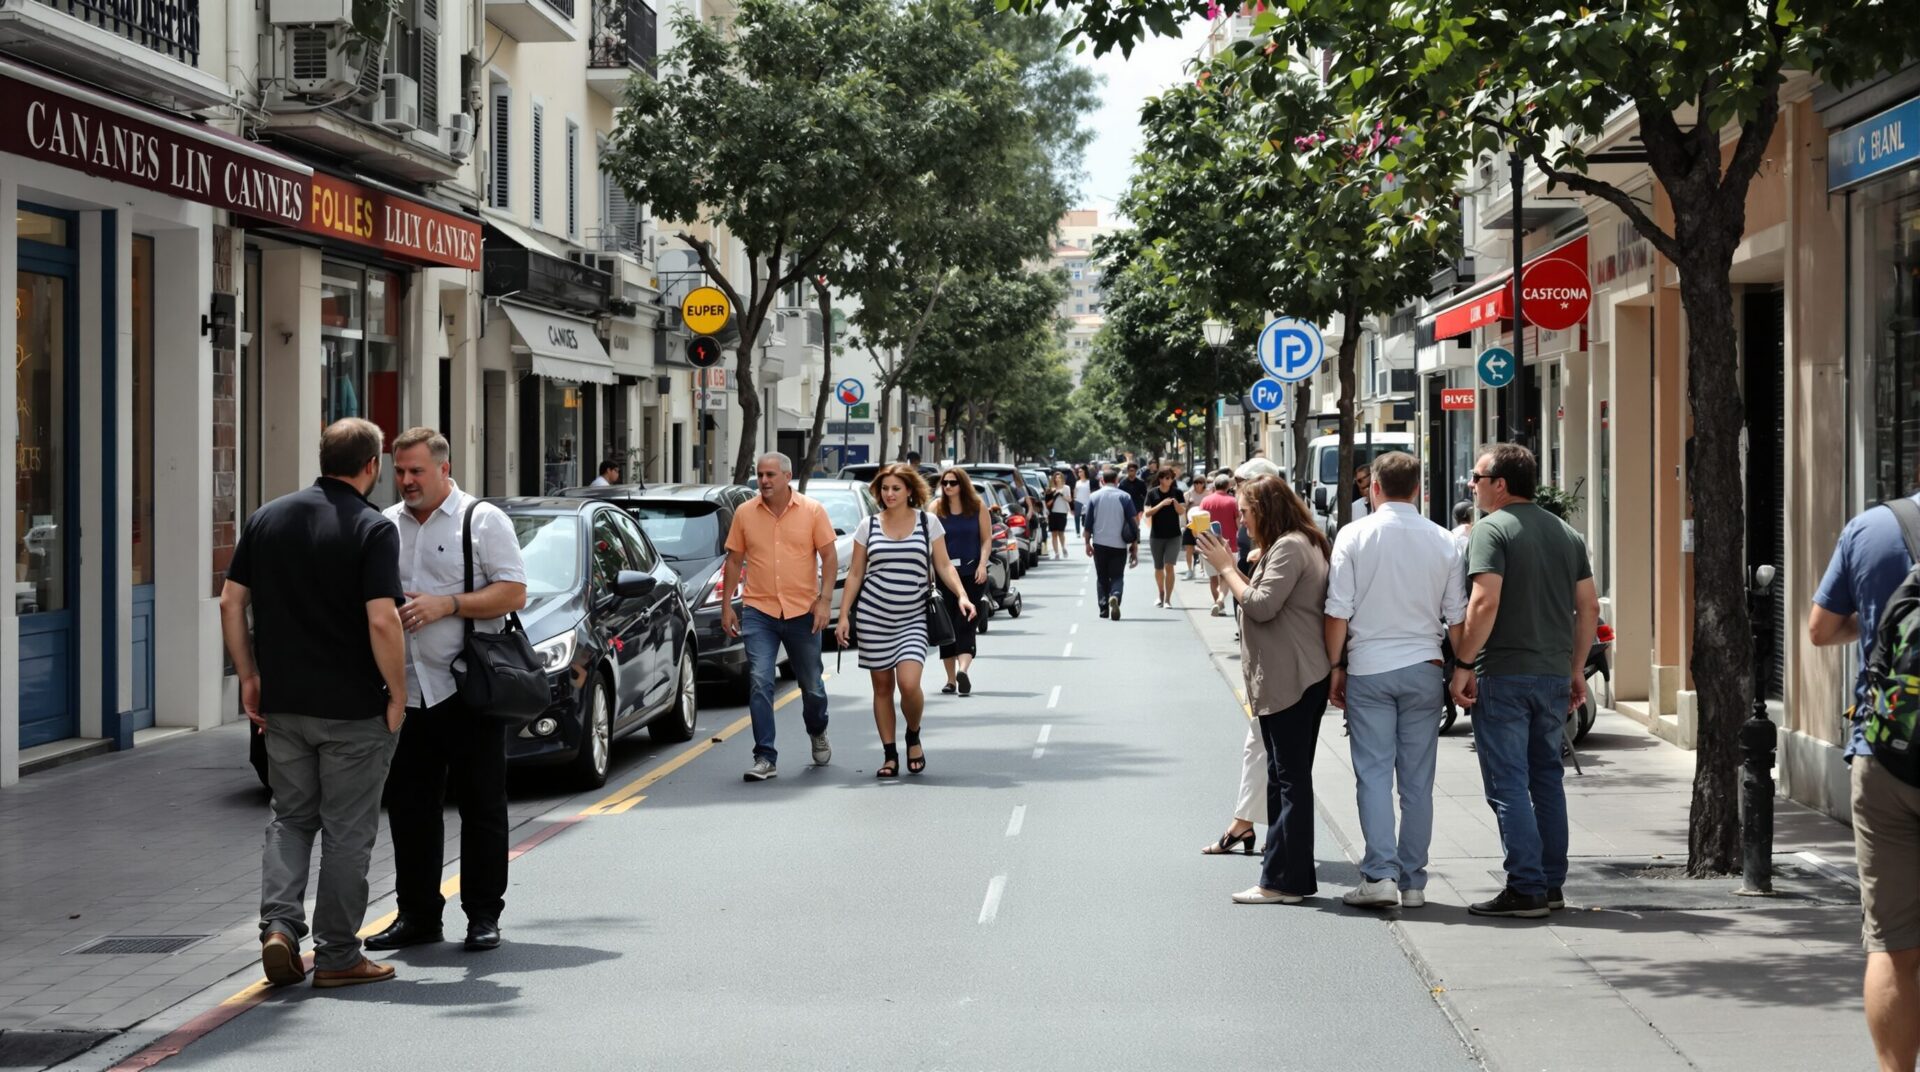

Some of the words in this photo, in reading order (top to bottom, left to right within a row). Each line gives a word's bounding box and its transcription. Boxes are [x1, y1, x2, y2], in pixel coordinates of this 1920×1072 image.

[26, 100, 160, 182] CANANES
[170, 143, 213, 197] LIN
[224, 161, 303, 222] CANNES
[311, 184, 373, 240] FOLLES
[384, 205, 422, 249] LLUX
[686, 304, 725, 317] EUPER
